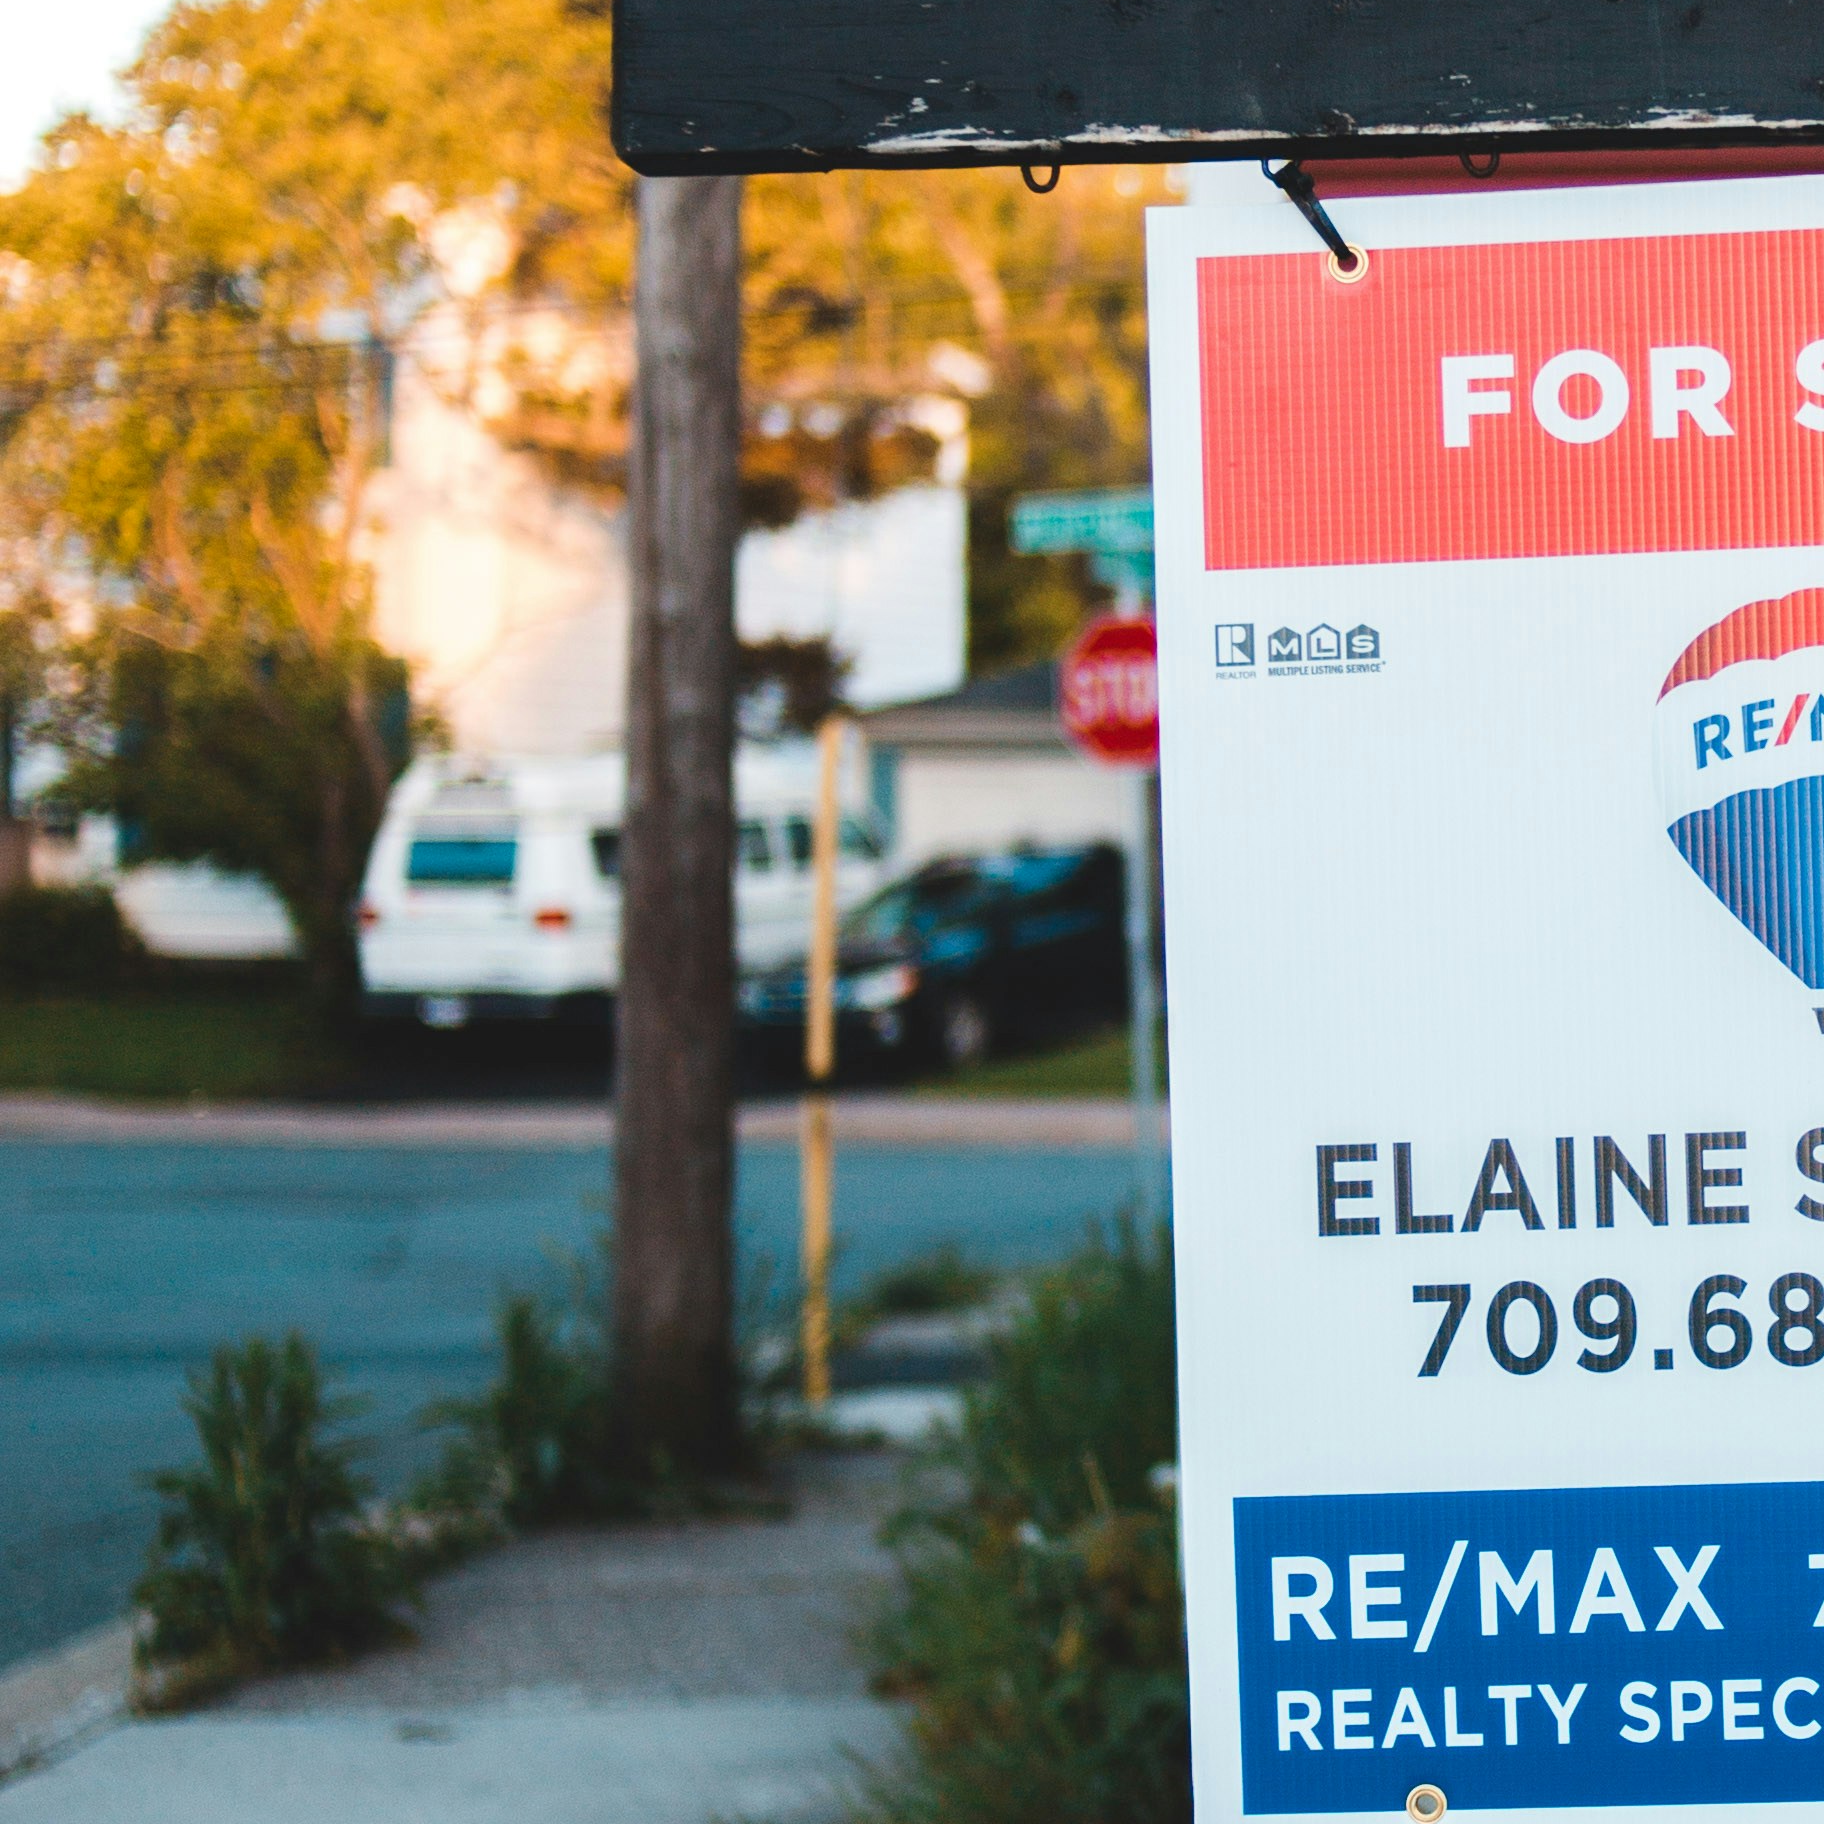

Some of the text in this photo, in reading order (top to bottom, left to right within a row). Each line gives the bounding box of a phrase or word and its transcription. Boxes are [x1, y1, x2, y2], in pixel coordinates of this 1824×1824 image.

[1441, 346, 1736, 448] FOR
[1215, 671, 1257, 680] REALTOR
[1267, 664, 1310, 677] MULTIPLE
[1311, 663, 1344, 676] LISTING
[1269, 629, 1378, 659] MLS
[1076, 659, 1156, 722] STO
[1316, 1131, 1750, 1238] ELAINE
[1272, 1541, 1724, 1653] RE/MAX
[1276, 1684, 1588, 1751] REALTY
